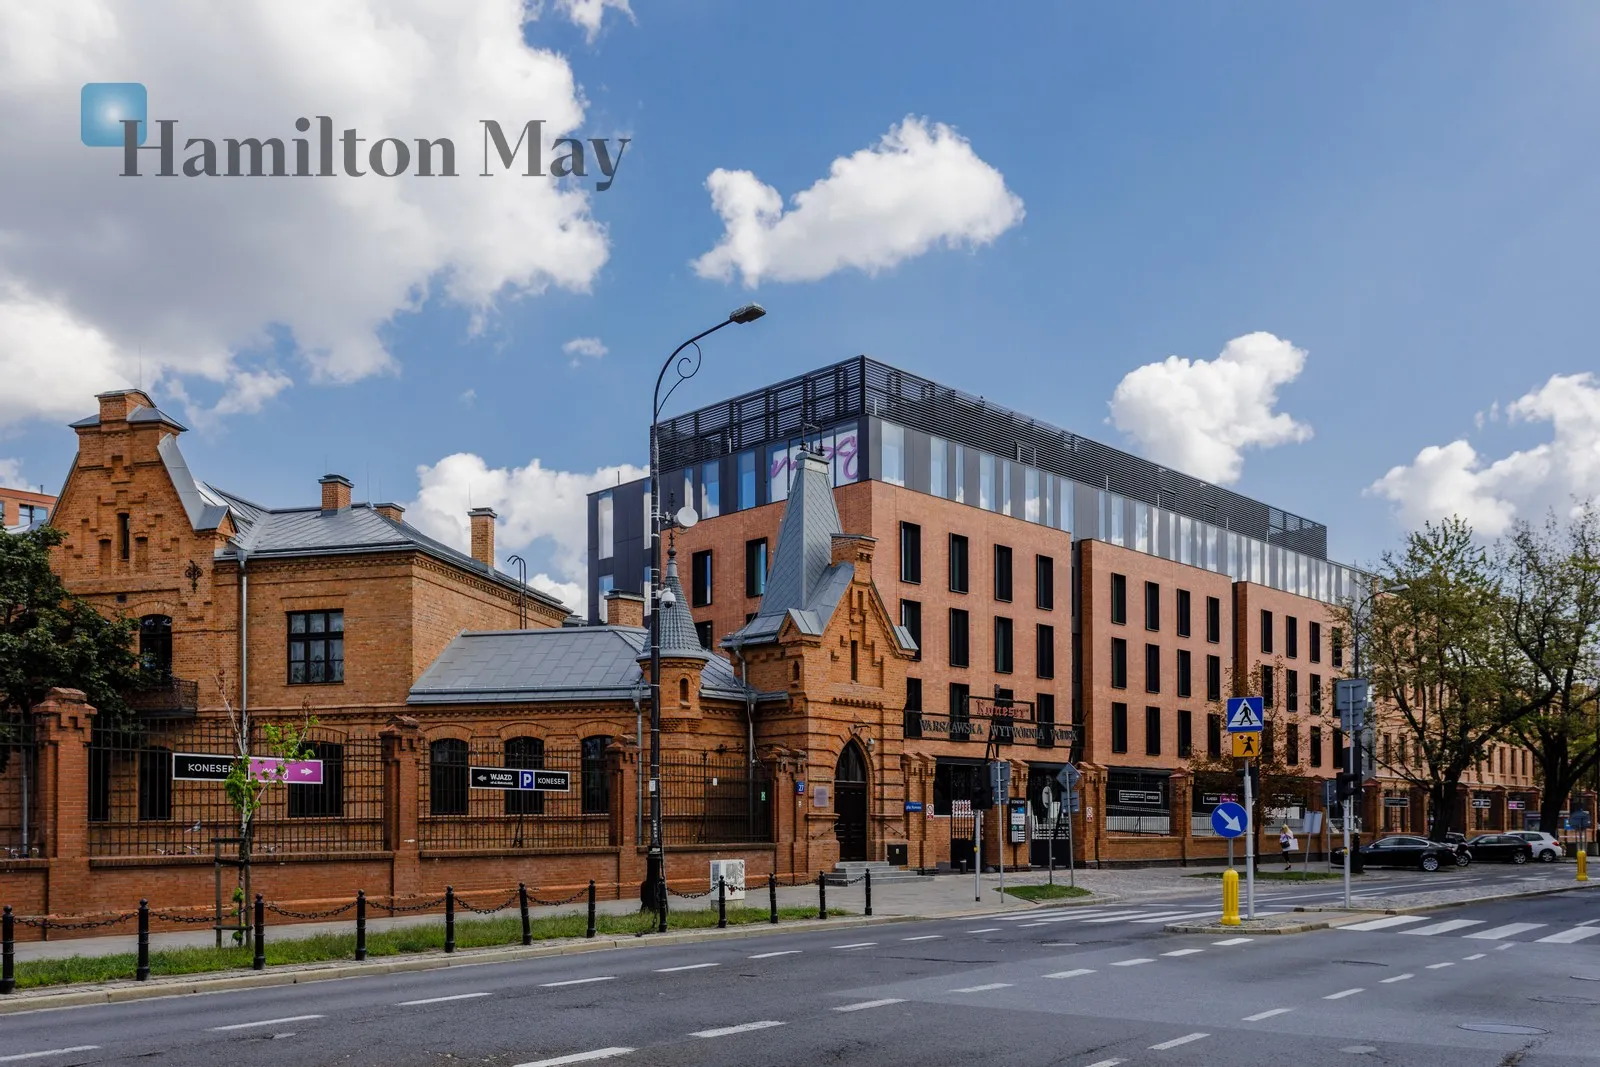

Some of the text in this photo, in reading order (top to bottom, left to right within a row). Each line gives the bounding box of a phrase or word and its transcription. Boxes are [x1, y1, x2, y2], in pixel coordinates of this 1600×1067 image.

[919, 719, 983, 735] WARSZAWSKA
[490, 773, 513, 781] WJAZD
[523, 773, 532, 786] P
[537, 777, 566, 785] KONESER
